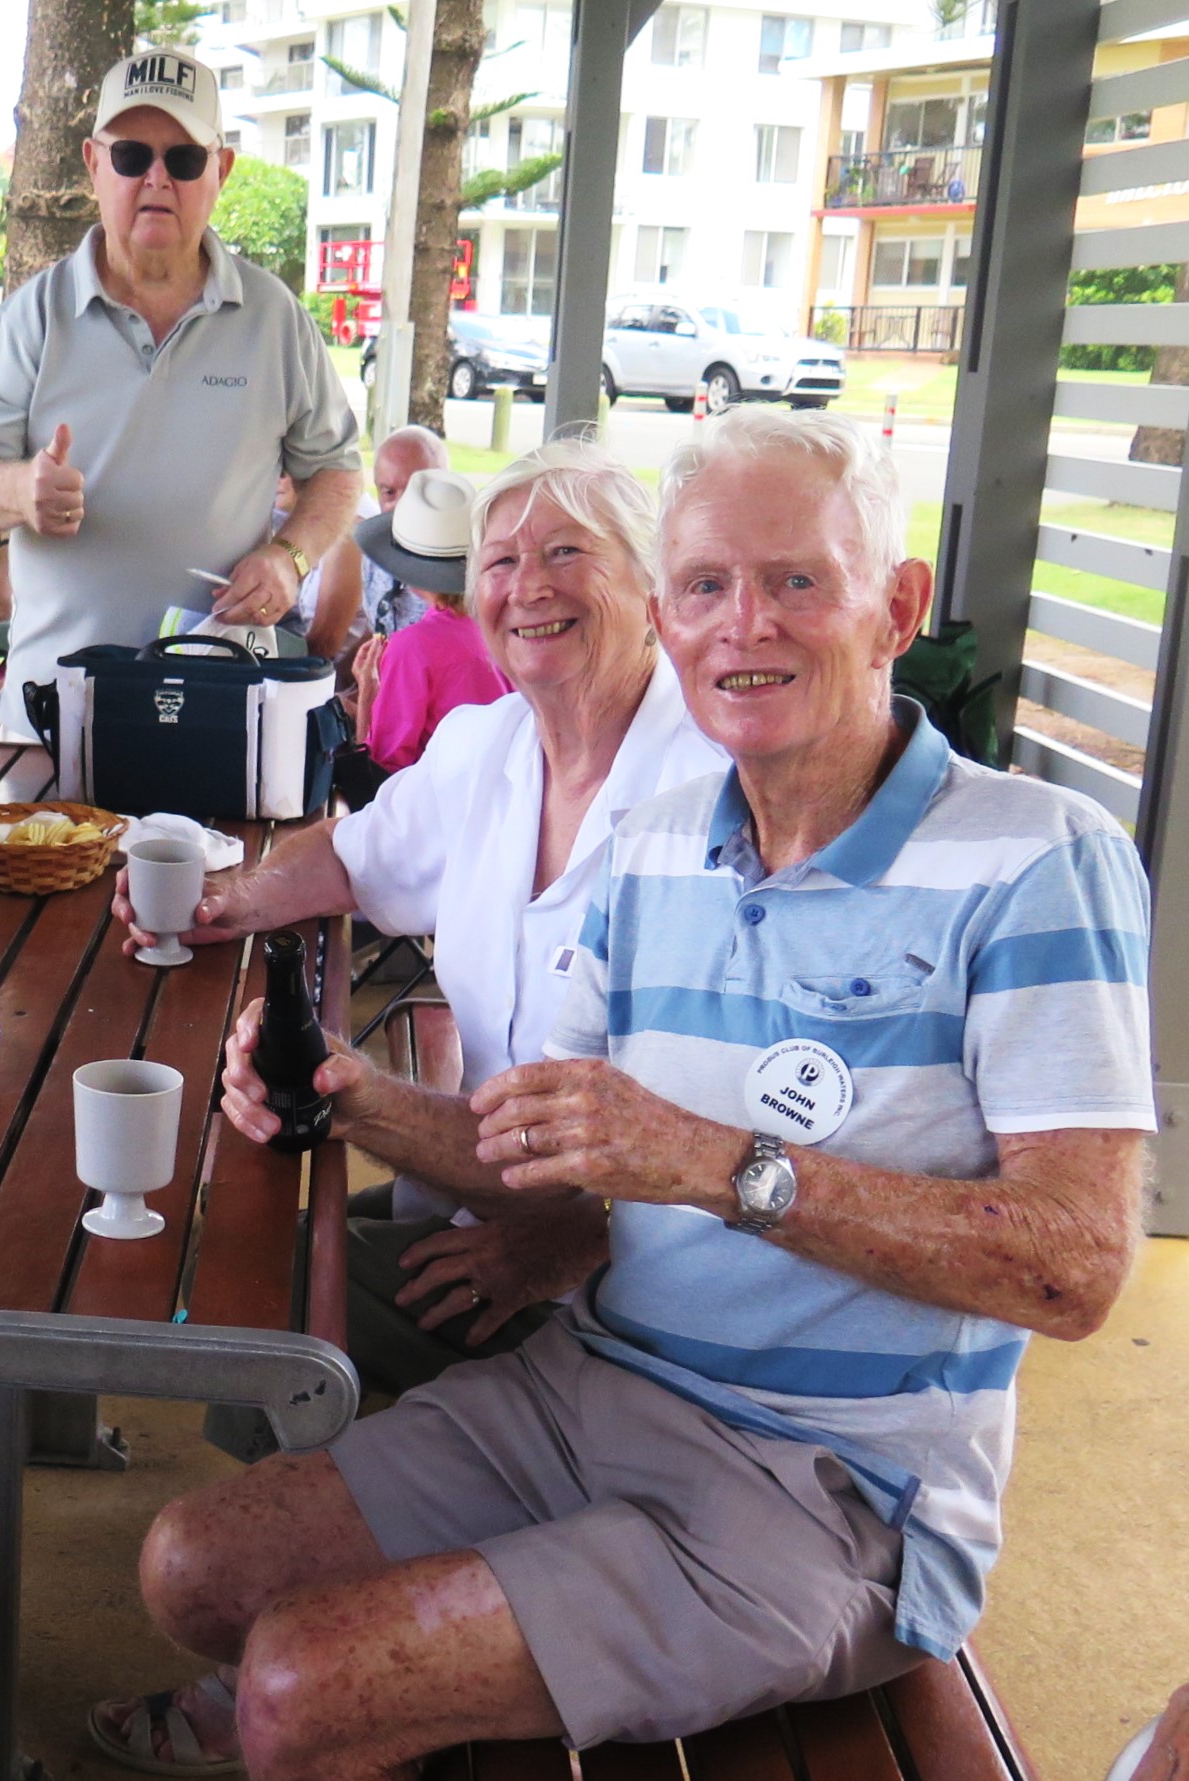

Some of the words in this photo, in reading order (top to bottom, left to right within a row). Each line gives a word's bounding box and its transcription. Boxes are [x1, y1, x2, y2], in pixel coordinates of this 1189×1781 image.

[128, 57, 194, 88] MILF
[124, 87, 139, 98] MAN
[144, 86, 164, 94] LOVE
[202, 375, 248, 387] ADAGIO
[781, 1045, 799, 1054] CLUB
[812, 1048, 840, 1074] BURLEIGH
[838, 1074, 846, 1103] WATERS
[760, 1093, 815, 1130] BROWNE
[780, 1087, 816, 1111] JOHN
